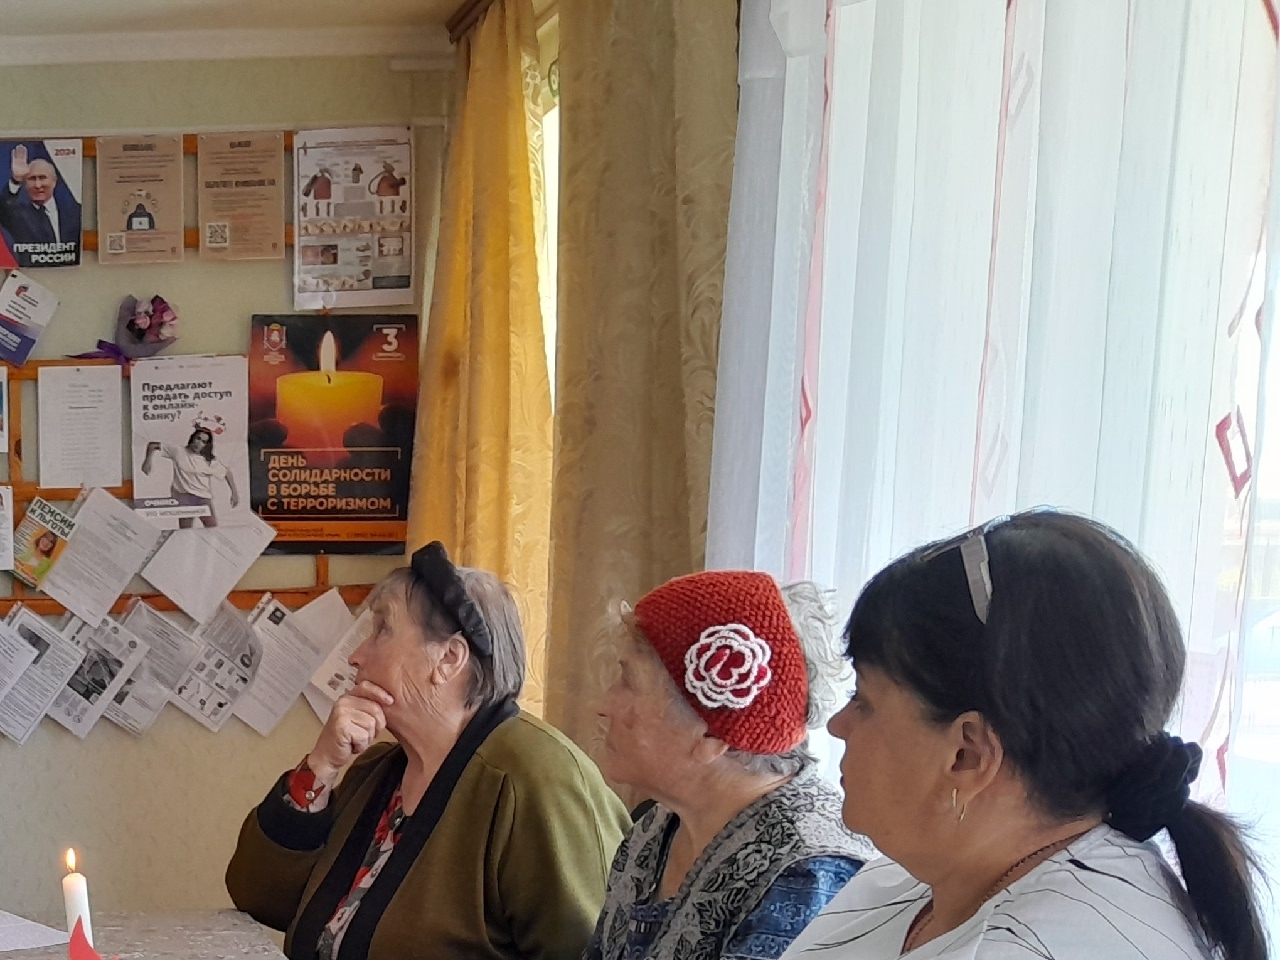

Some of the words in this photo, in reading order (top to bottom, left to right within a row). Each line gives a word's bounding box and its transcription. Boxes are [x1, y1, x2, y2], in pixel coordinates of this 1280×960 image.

[54, 148, 76, 156] 2024
[13, 242, 76, 253] ПРЕЗИДЕНТ
[31, 253, 76, 264] РОССИИ
[382, 328, 398, 352] 3
[142, 381, 213, 393] Предлагают
[142, 393, 190, 403] продать
[193, 391, 232, 400] доступ
[142, 410, 182, 422] банку?
[268, 455, 307, 469] ДЕНЬ
[268, 468, 391, 482] СОЛИДАРНОСТИ
[268, 484, 276, 496] В
[280, 483, 336, 496] БОРЬБЕ
[267, 498, 277, 510] С
[283, 497, 392, 510] ТЕРРОРИЗМОМ
[33, 498, 77, 531] ПЕНСИИ
